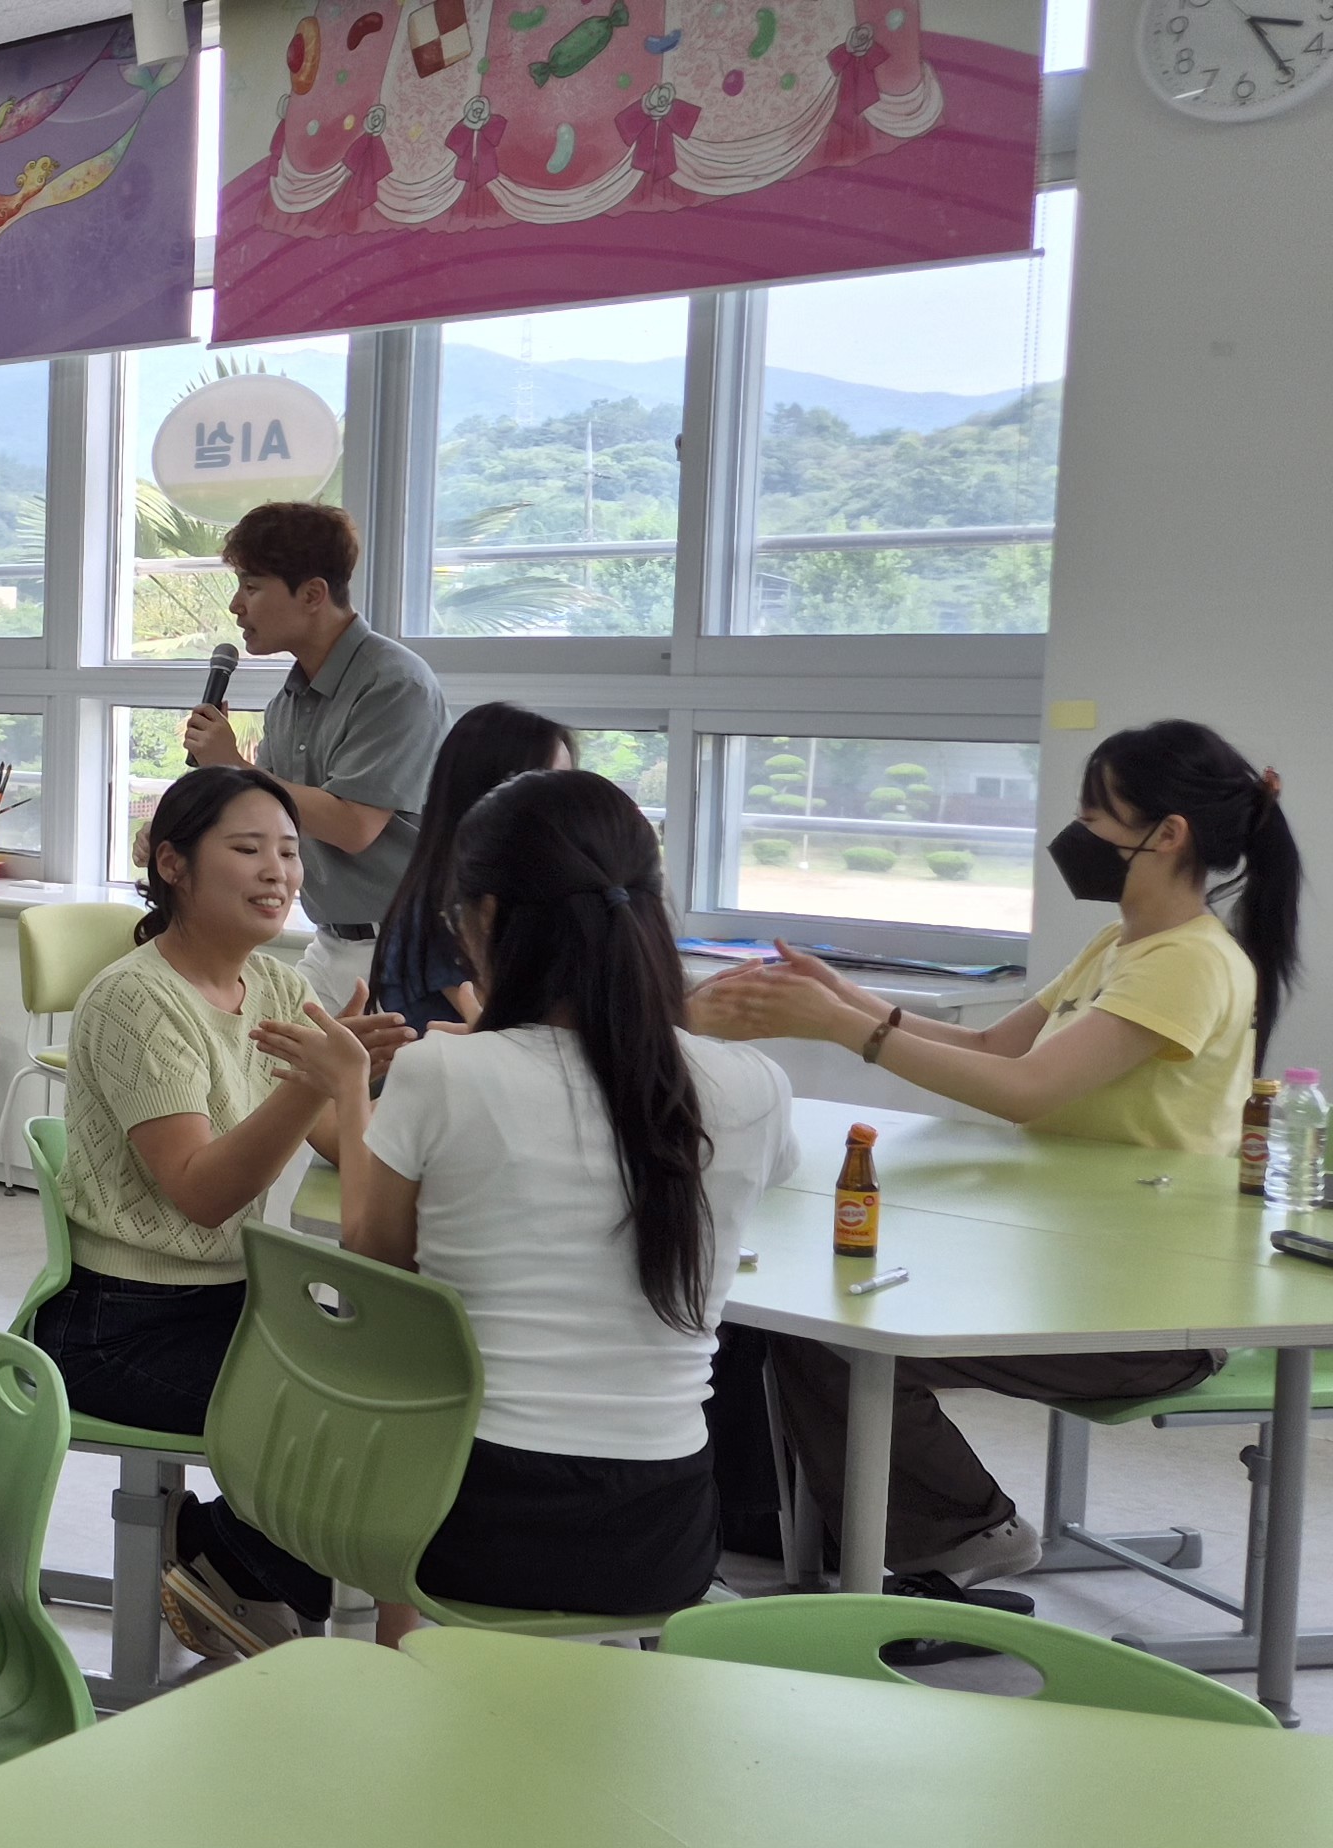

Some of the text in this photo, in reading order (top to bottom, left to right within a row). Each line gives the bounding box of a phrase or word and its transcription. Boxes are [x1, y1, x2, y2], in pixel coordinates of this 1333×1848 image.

[1166, 15, 1190, 43] 9
[1301, 31, 1326, 56] 4
[1174, 48, 1195, 75] 8
[1200, 68, 1221, 92] 7
[1235, 72, 1256, 99] 6
